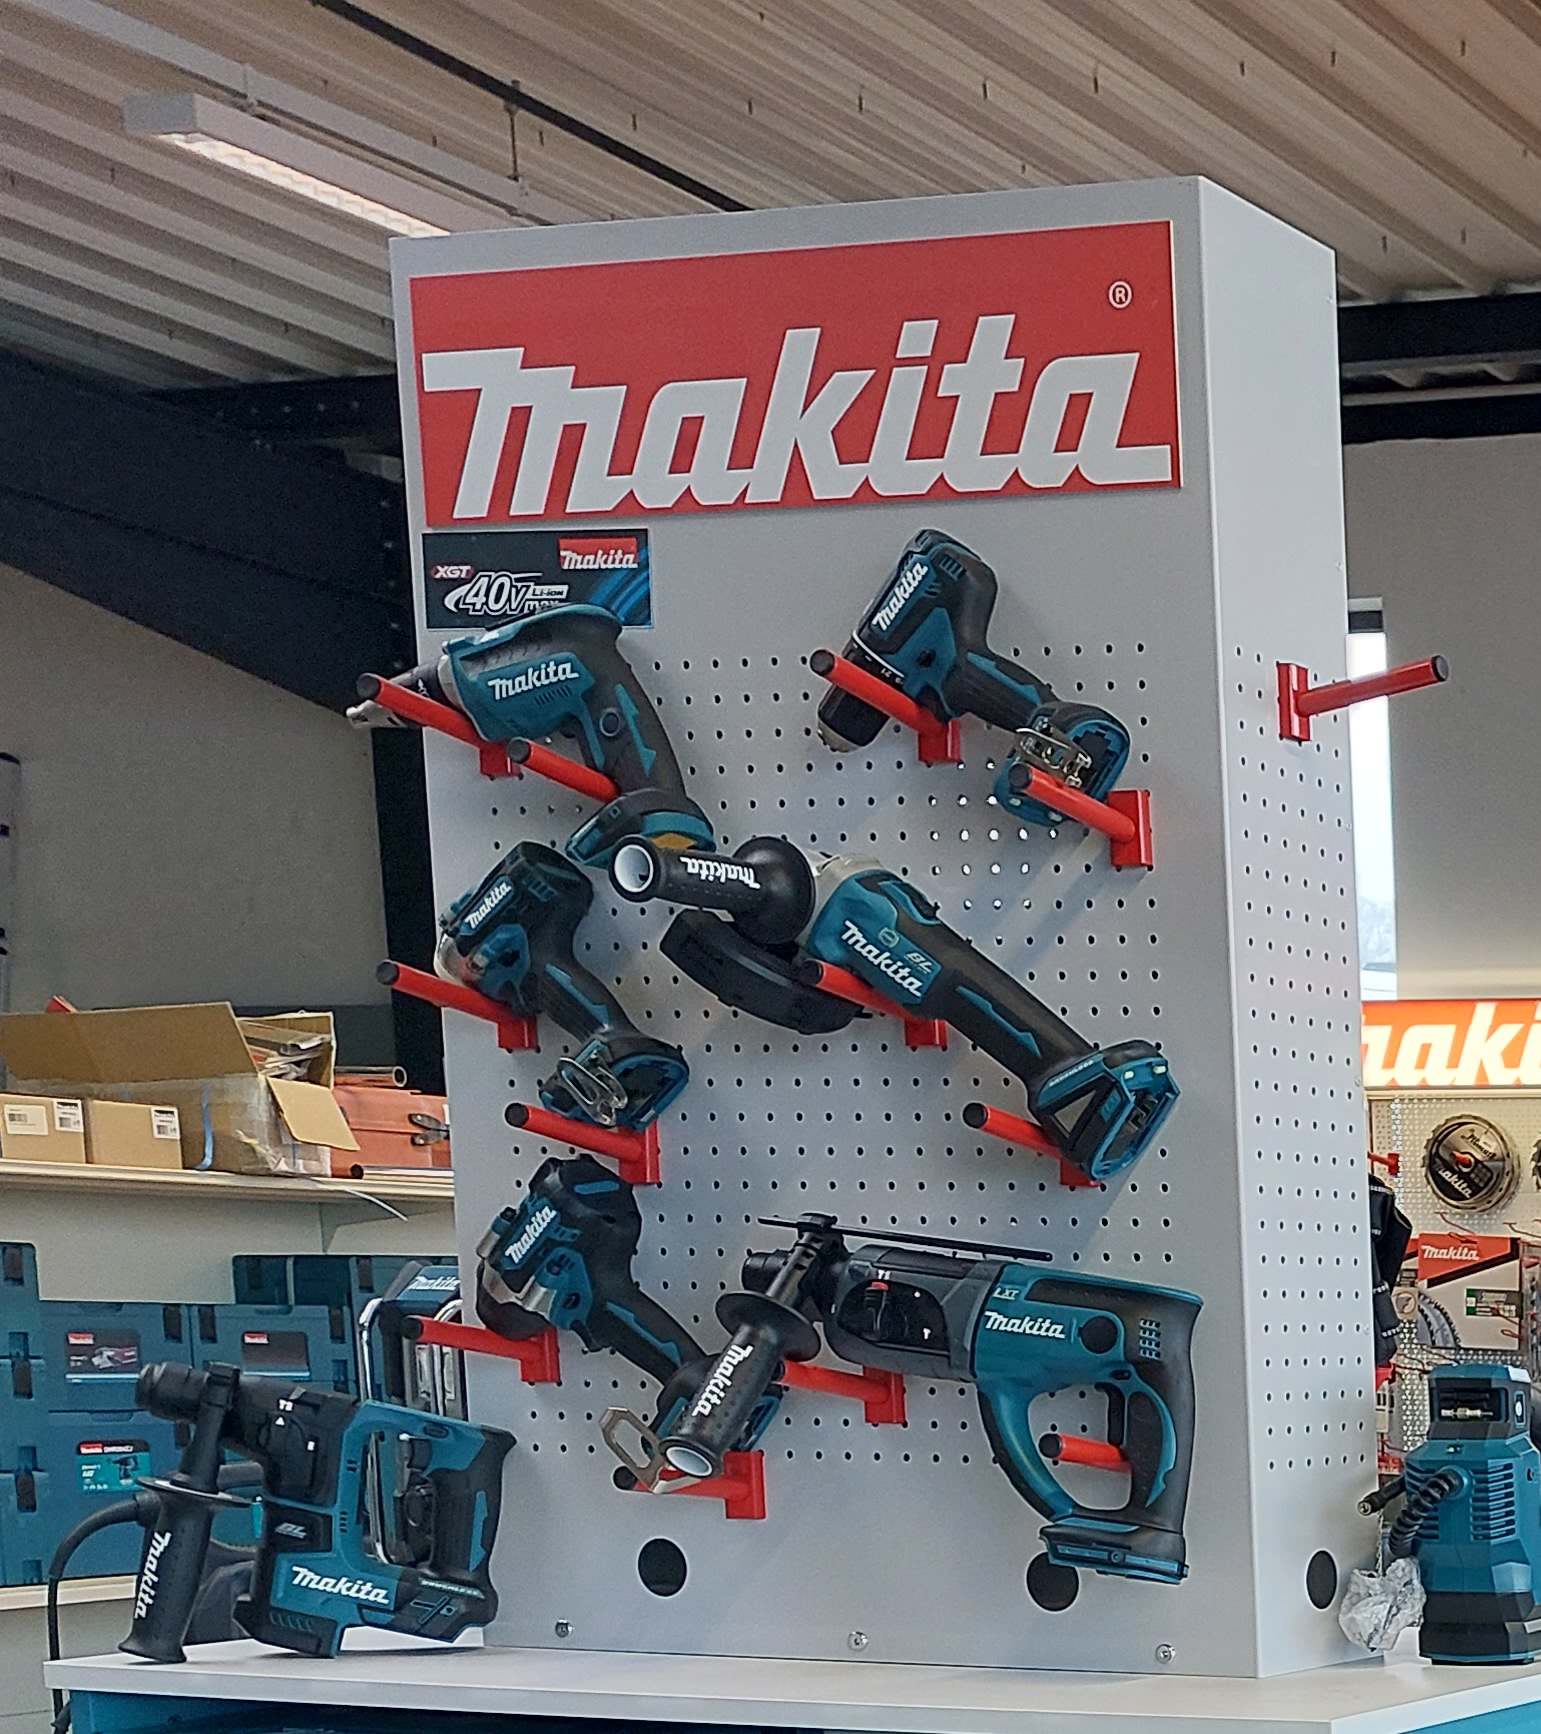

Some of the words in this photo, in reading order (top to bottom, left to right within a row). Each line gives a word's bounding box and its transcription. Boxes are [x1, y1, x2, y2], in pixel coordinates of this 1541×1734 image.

[421, 314, 1171, 518] Makita
[433, 566, 472, 579] XGT
[560, 551, 638, 569] Makita
[872, 562, 928, 630] Makita
[488, 662, 579, 700] Makita
[680, 857, 760, 889] Makita
[465, 881, 512, 929] Makita
[841, 920, 922, 998] Makita
[1433, 1161, 1472, 1198] Makita
[504, 1204, 558, 1264] Makita
[1422, 1245, 1479, 1261] Makita
[984, 1311, 1066, 1339] Makita
[692, 1344, 753, 1418] Makita
[133, 1532, 171, 1620] Makita
[292, 1566, 388, 1604] Makita
